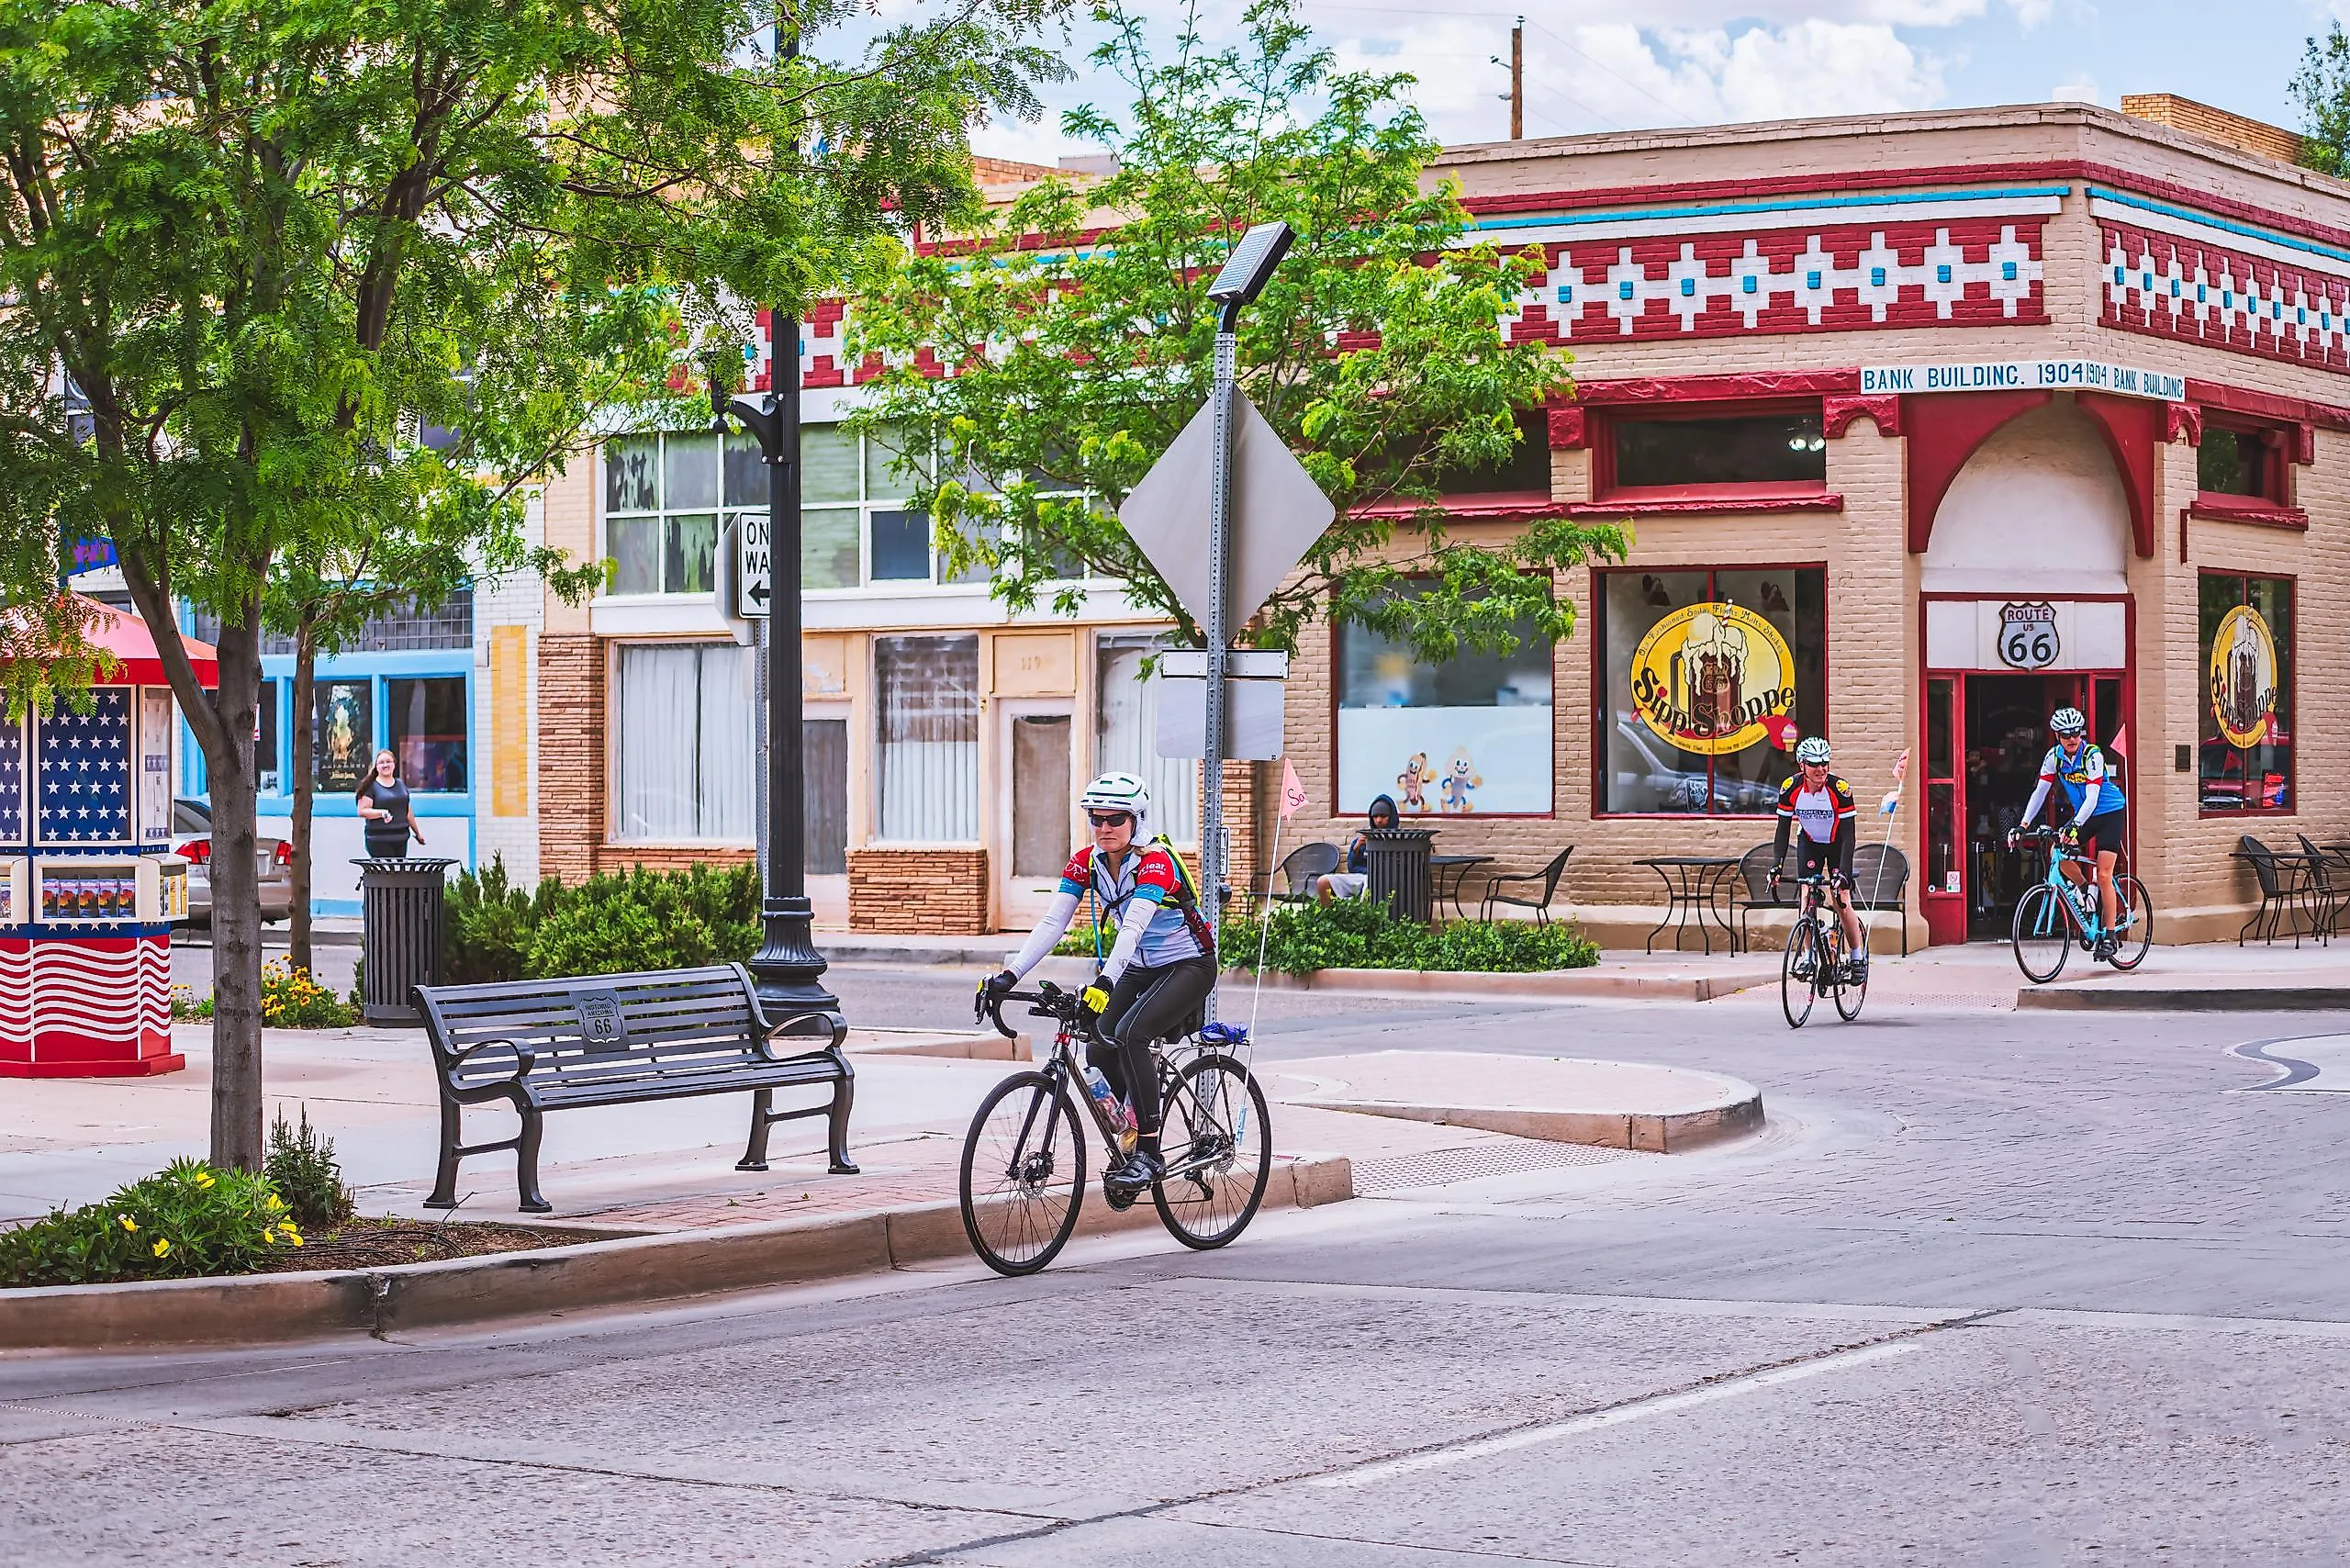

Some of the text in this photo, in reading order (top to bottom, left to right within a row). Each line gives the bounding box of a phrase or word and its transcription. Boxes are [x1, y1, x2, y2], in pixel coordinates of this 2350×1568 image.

[1863, 363, 2084, 390] BANK BUILDING. 1904
[2086, 363, 2184, 398] 1904 BANK BUILDING
[746, 521, 769, 545] ON
[745, 551, 771, 575] WA
[2008, 609, 2050, 621] ROUTE
[2022, 623, 2034, 632] US
[2008, 633, 2052, 662] 66
[1634, 667, 1796, 737] Sipp Shoppe
[594, 1018, 612, 1035] 66
